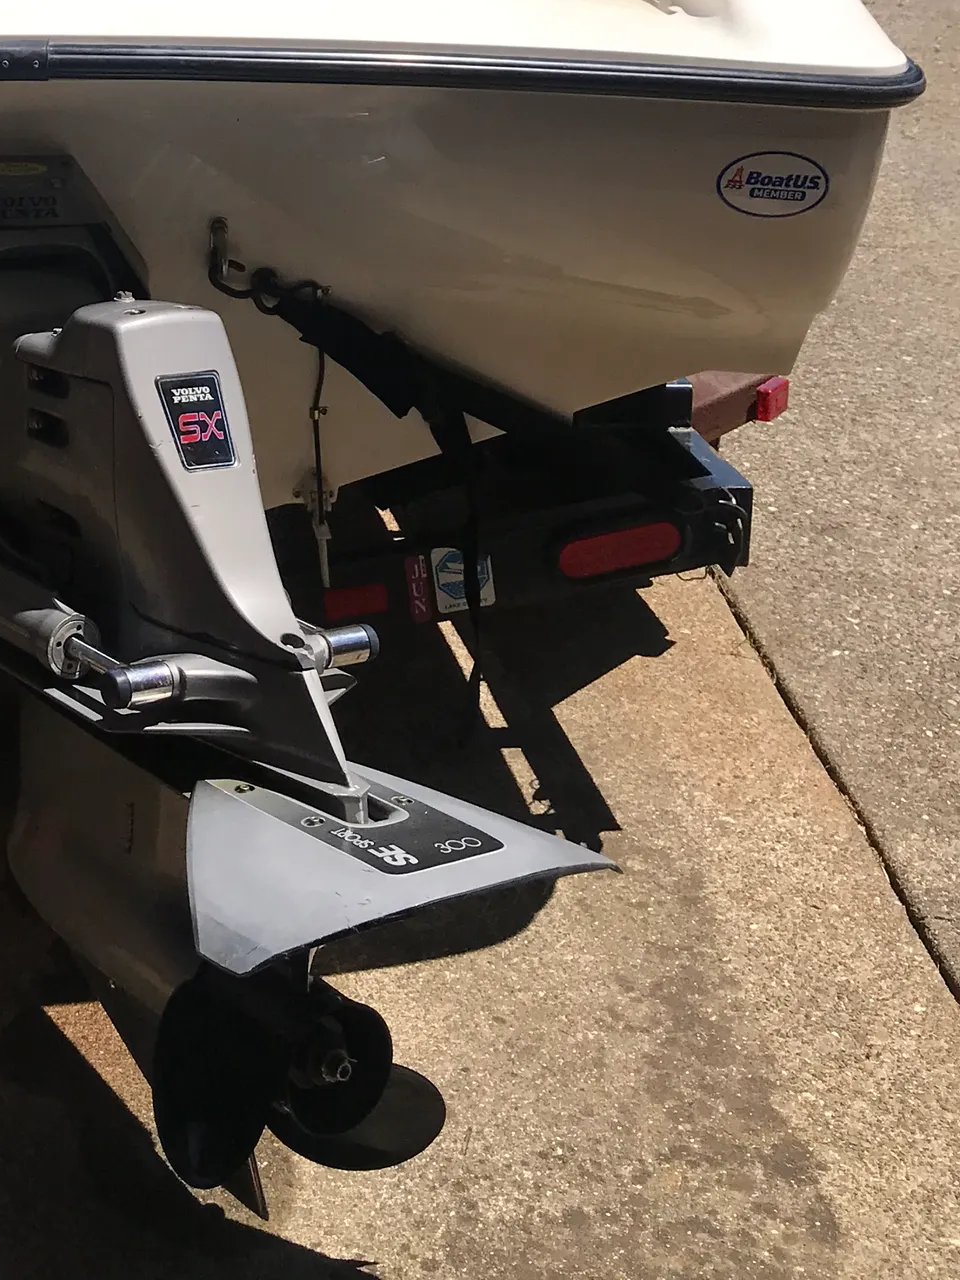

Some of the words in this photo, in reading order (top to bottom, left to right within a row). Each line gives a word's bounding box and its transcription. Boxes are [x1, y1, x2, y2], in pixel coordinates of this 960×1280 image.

[753, 189, 803, 201] MEMBER
[171, 386, 211, 396] VOLVO
[172, 393, 214, 404] PENTA
[178, 410, 225, 444] SX
[330, 827, 375, 849] SPORT
[434, 836, 482, 854] 300
[367, 844, 419, 867] SE
